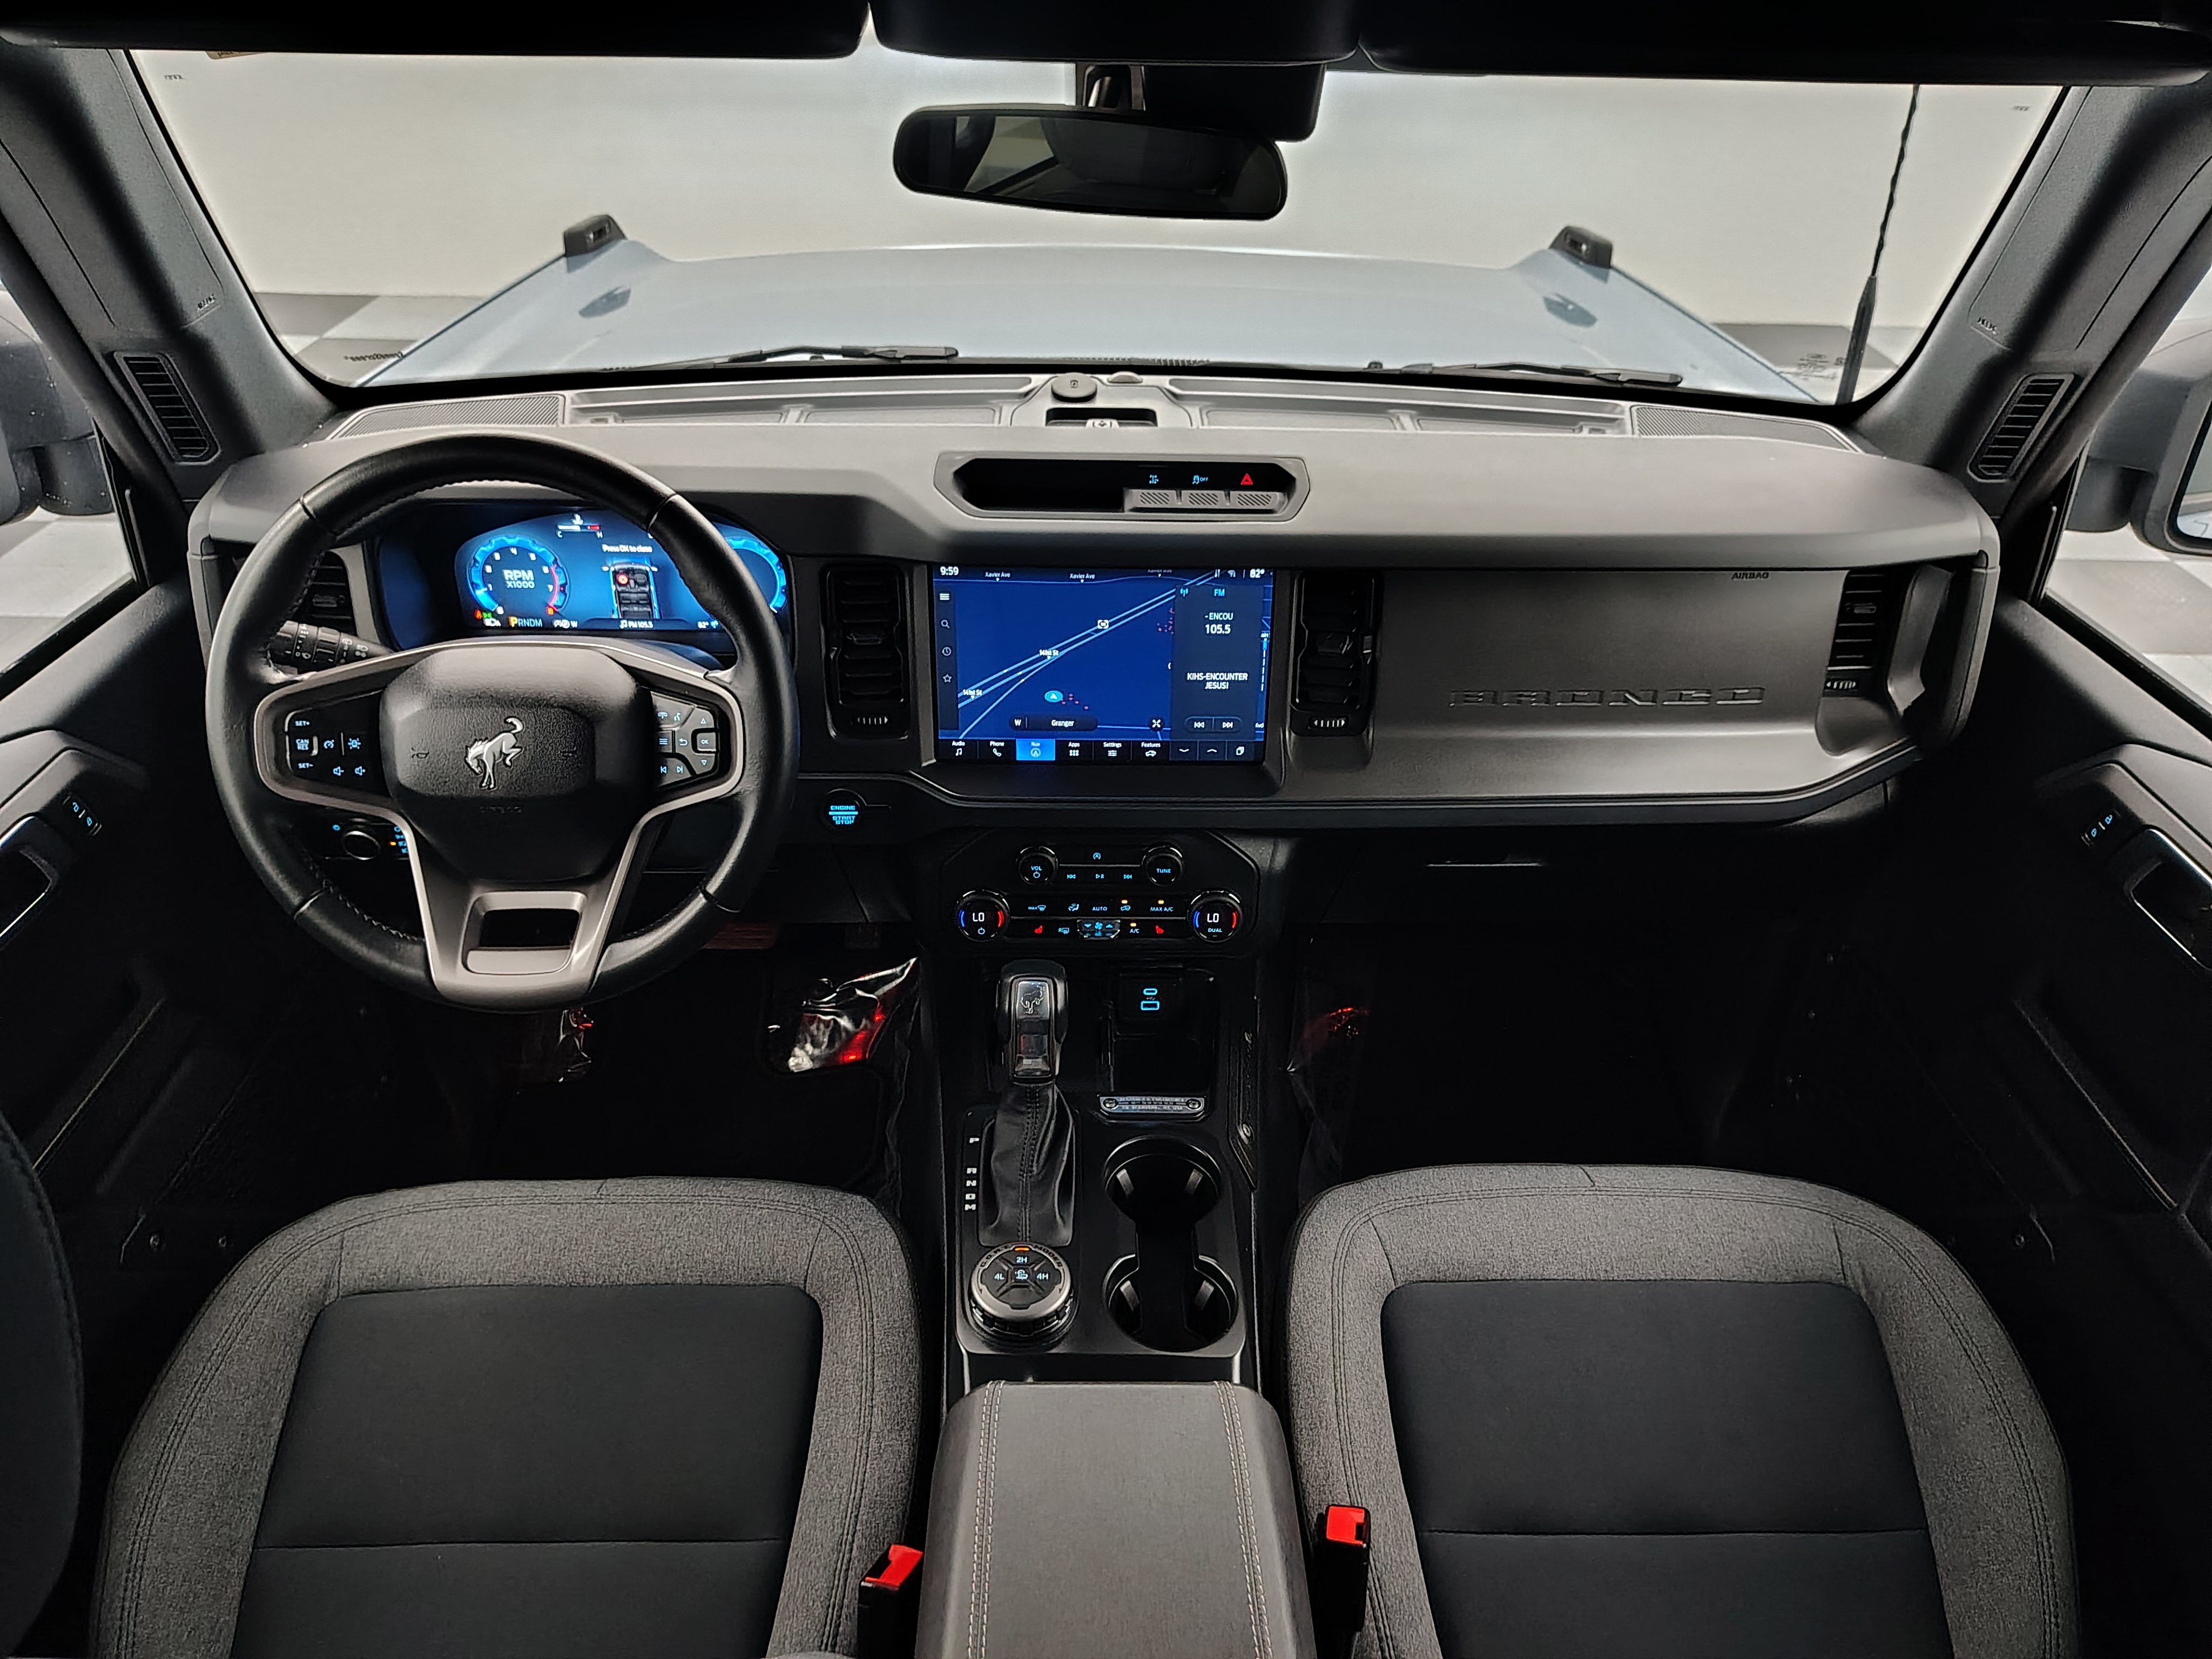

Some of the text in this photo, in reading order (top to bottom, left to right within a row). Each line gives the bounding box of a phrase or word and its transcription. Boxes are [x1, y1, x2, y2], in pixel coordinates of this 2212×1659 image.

[503, 570, 534, 581] RPM
[940, 566, 959, 576] 9:59
[505, 581, 535, 589] X1000
[1213, 588, 1225, 597] FM
[1205, 624, 1231, 634] 105.5
[1187, 673, 1249, 681] KIHS-ENCOUNTER
[1449, 689, 1765, 707] BRONCO
[1051, 719, 1075, 727] Granger
[972, 912, 985, 922] LO
[1206, 913, 1219, 923] LO
